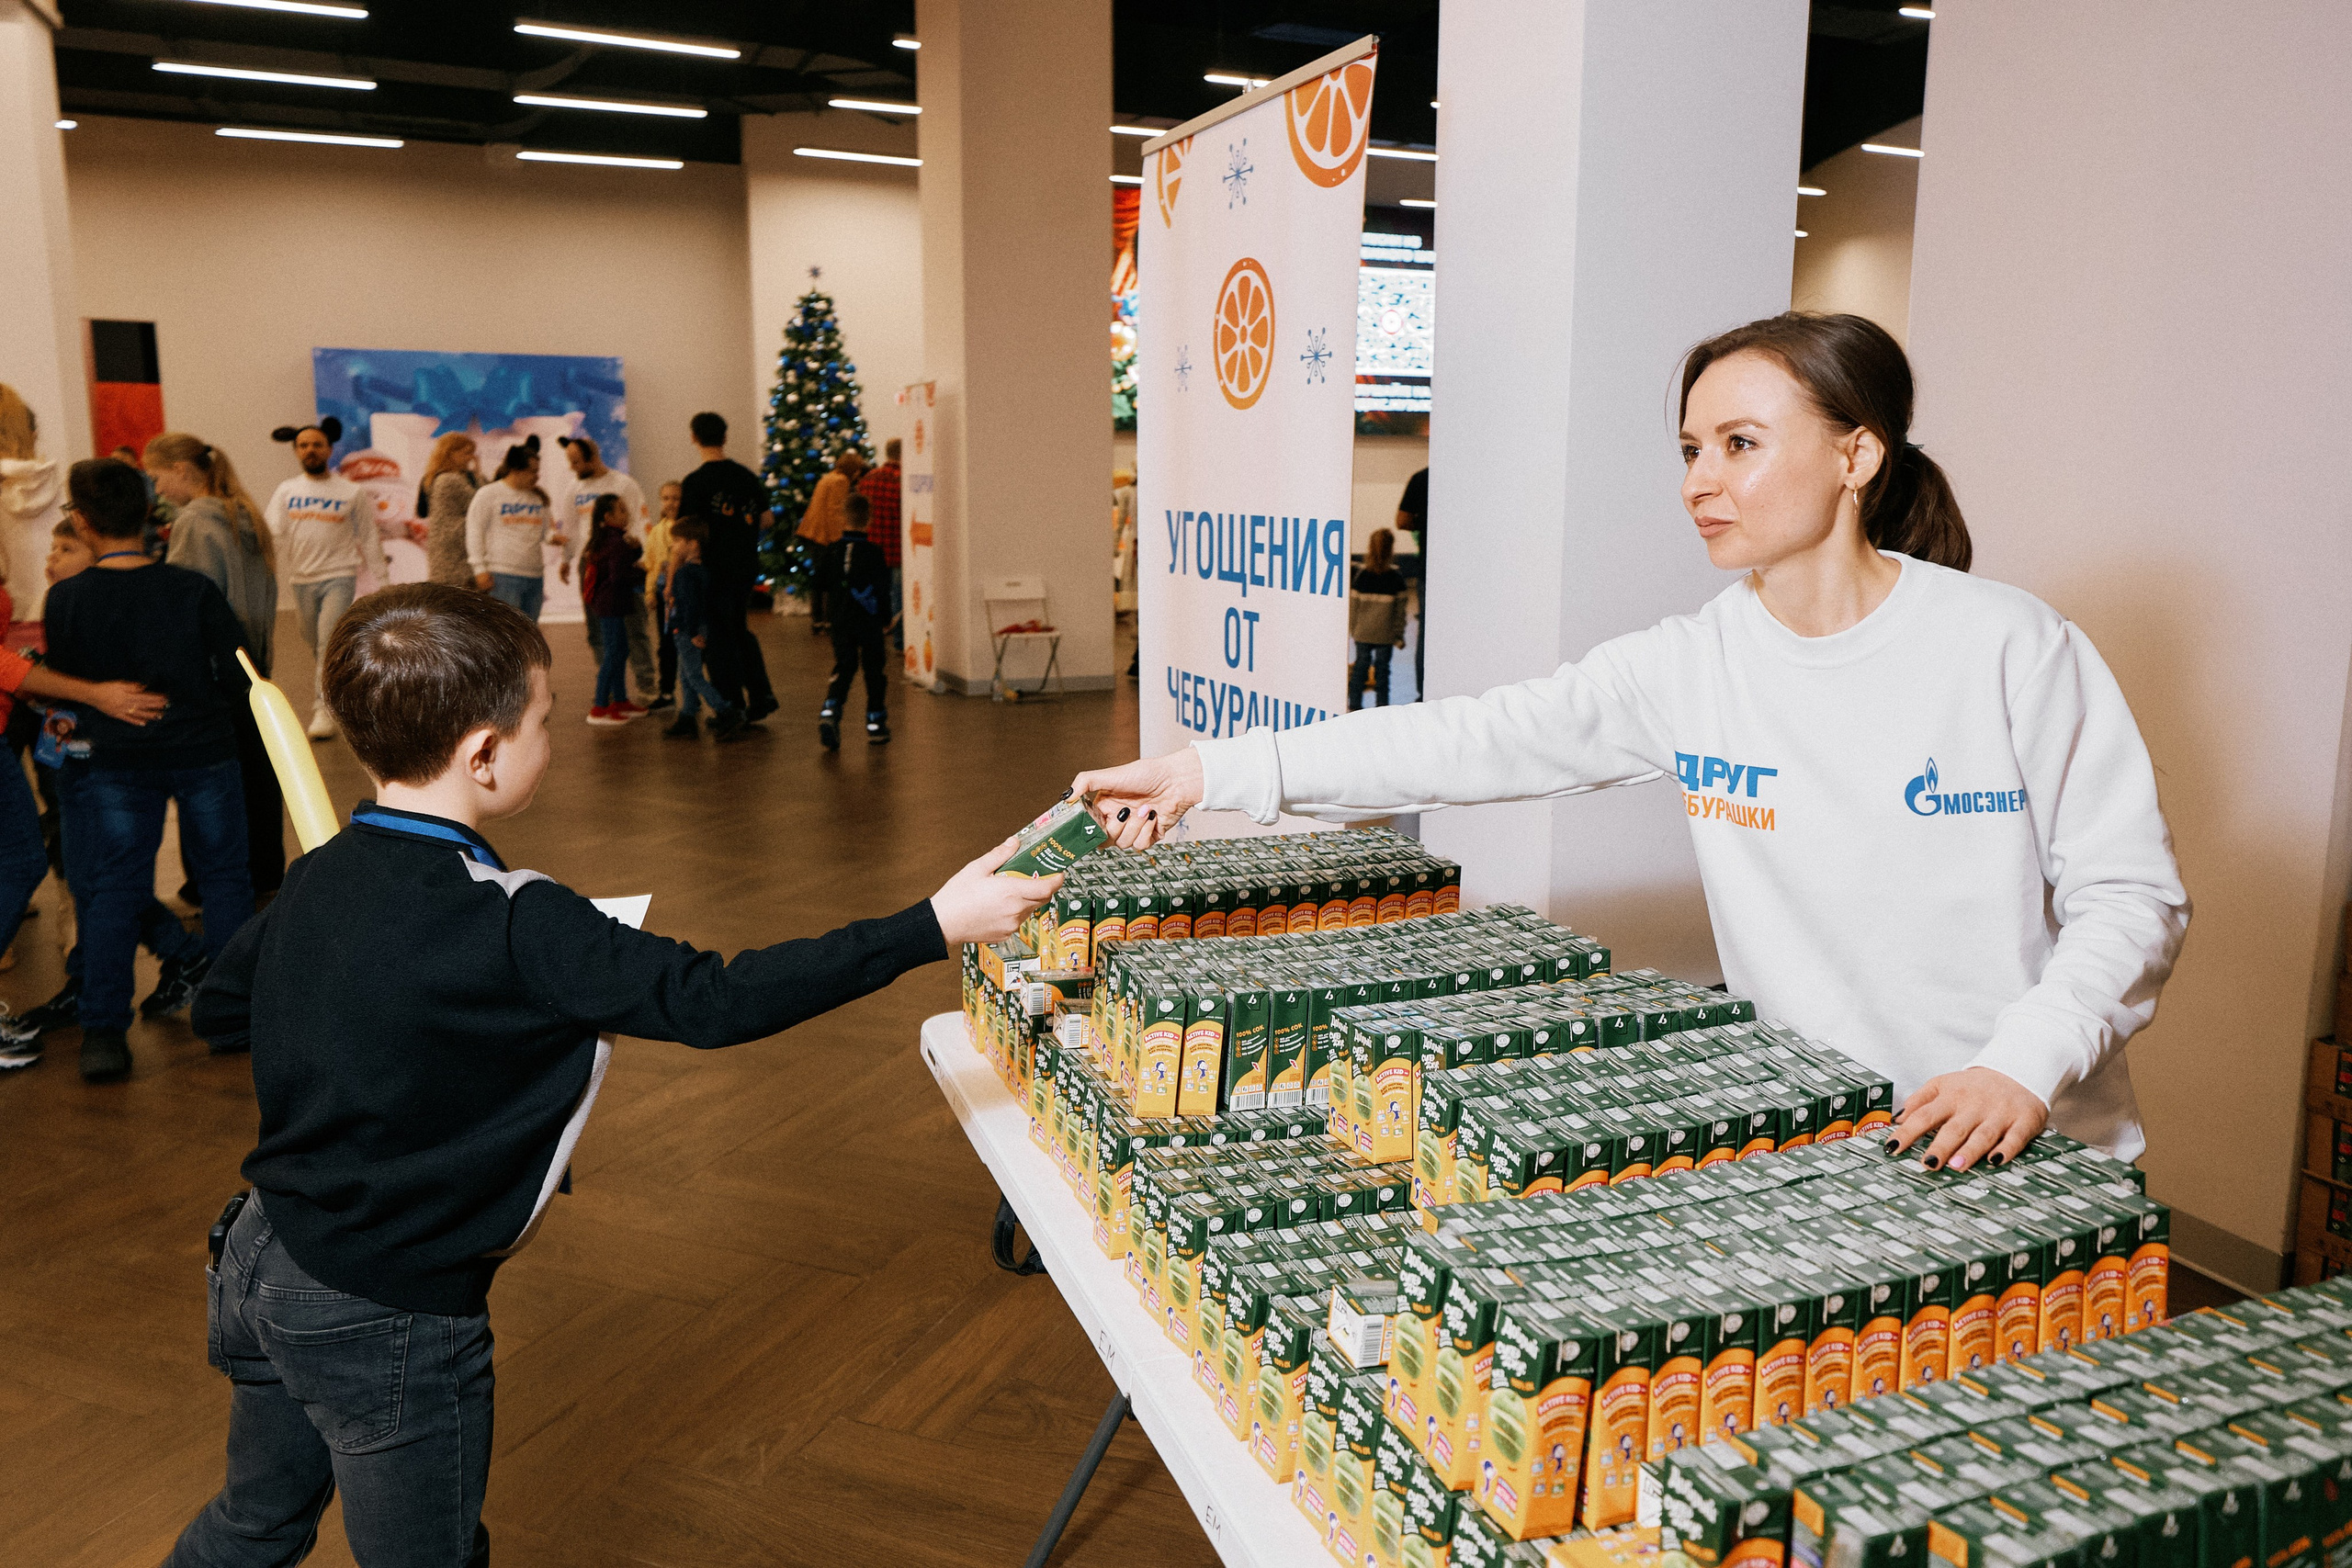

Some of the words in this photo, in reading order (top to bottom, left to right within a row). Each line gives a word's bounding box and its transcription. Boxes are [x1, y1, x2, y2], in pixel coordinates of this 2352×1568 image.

[1166, 510, 1344, 598] УГОЩЕНИЯ
[1224, 606, 1260, 672] ОТ
[1168, 666, 1339, 739] ЧЕБУРАШ
[1674, 750, 1778, 797] ДРУГ
[1682, 791, 1775, 831] БУРАШКИ
[1943, 789, 2025, 815] МОСЭНЕР
[1048, 837, 1063, 852] 100%
[1145, 1032, 1163, 1042] ACTIVE
[1186, 1031, 1204, 1041] ACTIVE
[1236, 1028, 1251, 1038] 100%
[1253, 1024, 1264, 1033] СОК
[1275, 1027, 1290, 1035] 100%
[1376, 1069, 1393, 1082] ACTIVE
